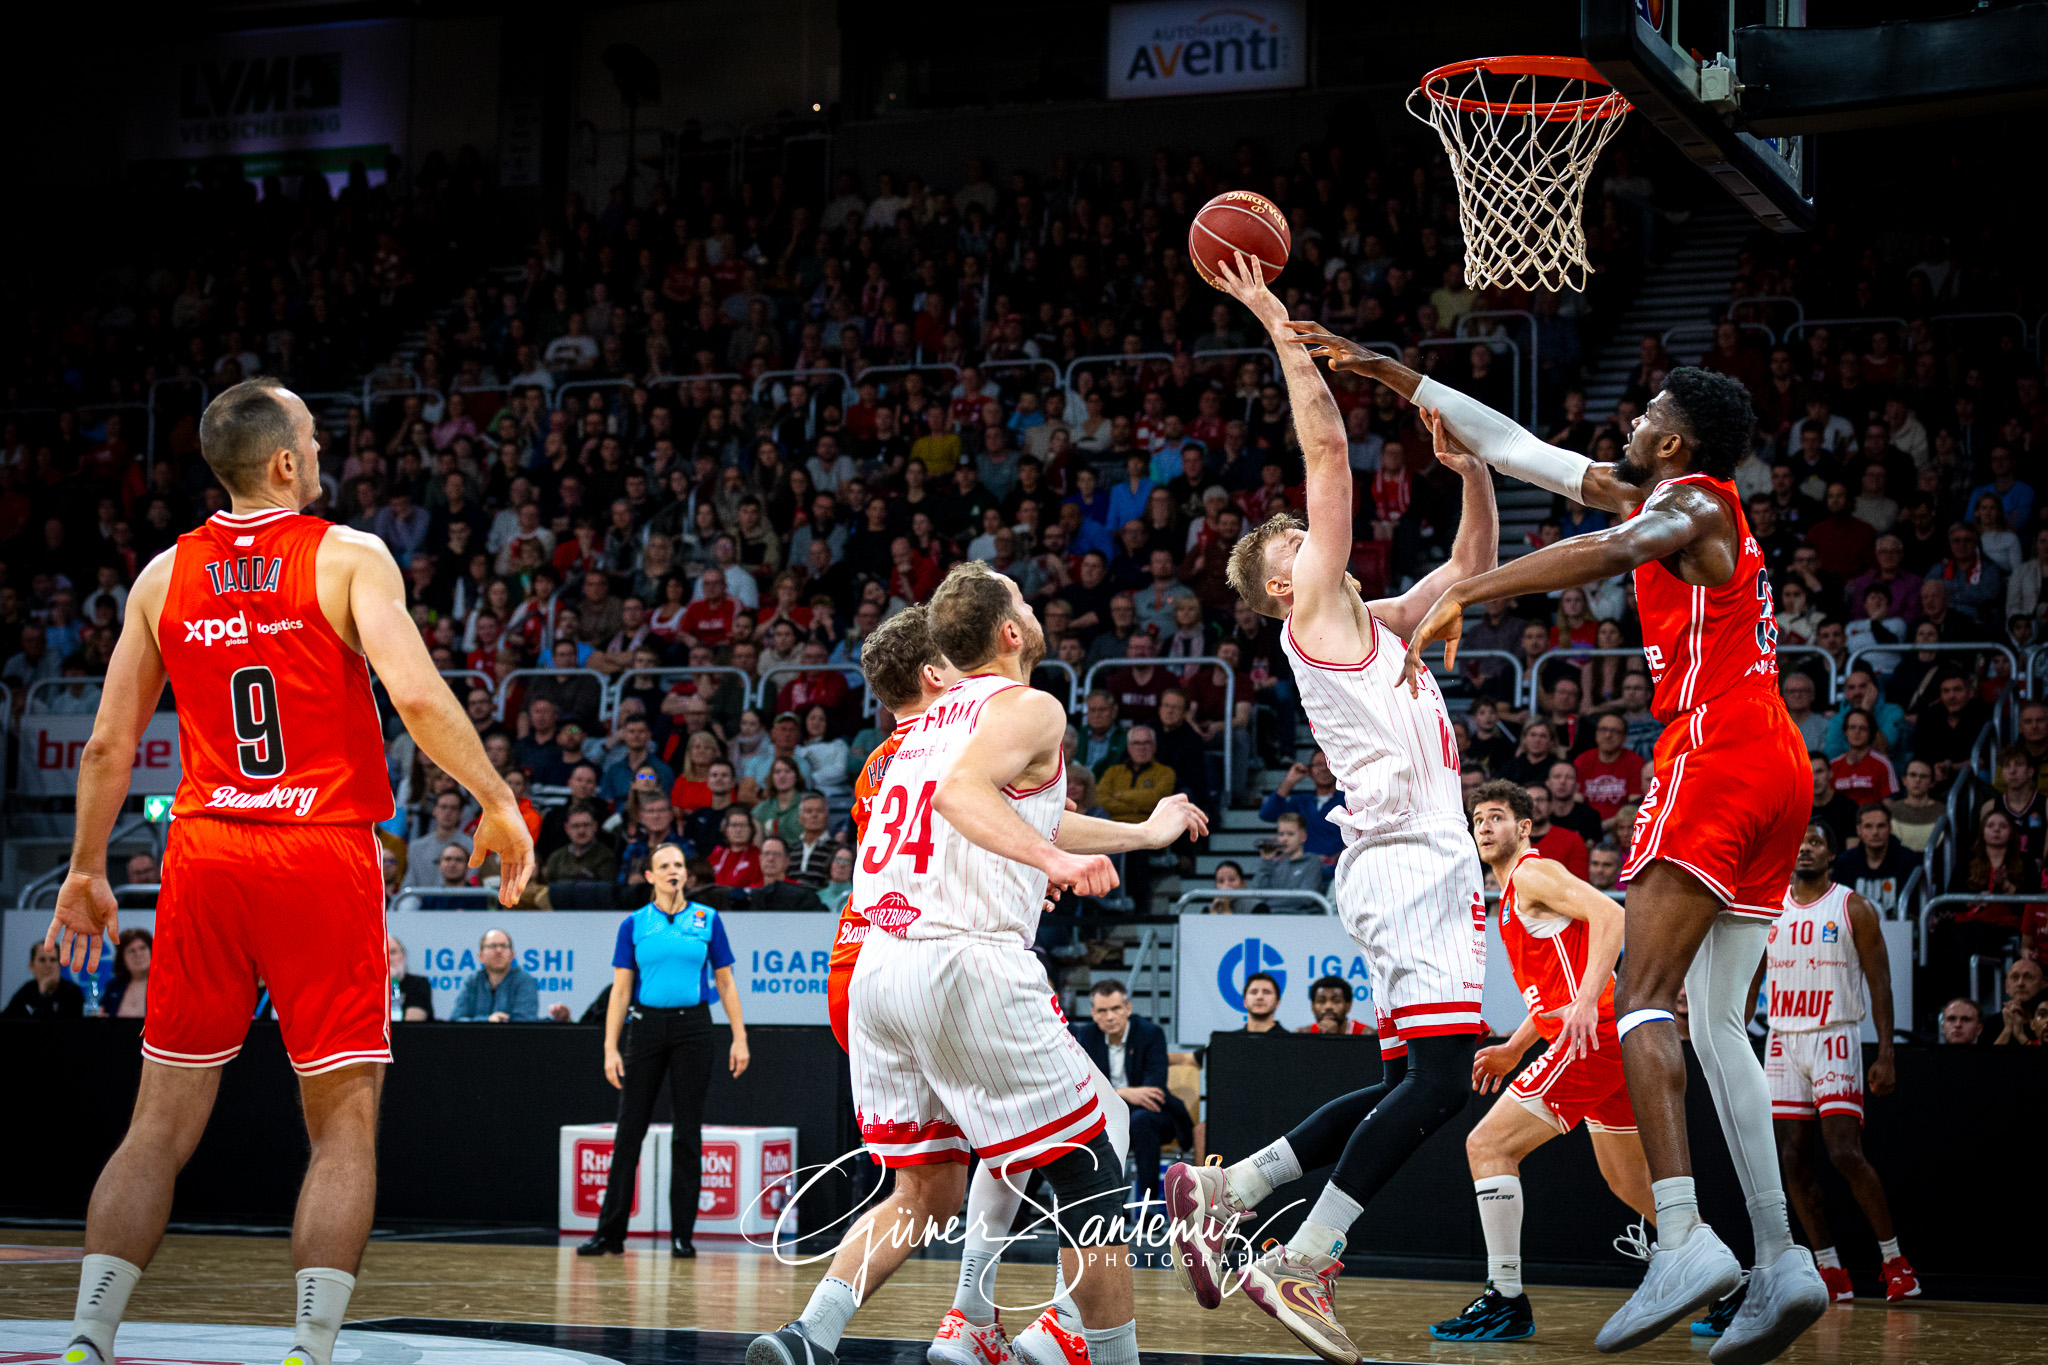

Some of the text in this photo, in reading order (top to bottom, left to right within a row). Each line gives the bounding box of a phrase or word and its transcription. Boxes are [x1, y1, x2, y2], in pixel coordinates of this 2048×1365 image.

[1226, 192, 1287, 231] SPALDING
[183, 610, 304, 647] xpd logistics
[225, 638, 249, 648] global
[230, 665, 287, 779] 9
[38, 729, 173, 770] bre
[205, 784, 319, 817] Bamberg
[862, 780, 937, 875] 34
[1789, 920, 1814, 946] 10
[425, 949, 573, 971] IGASHI
[1770, 981, 1834, 1026] KNAUF
[1823, 1035, 1849, 1061] 10
